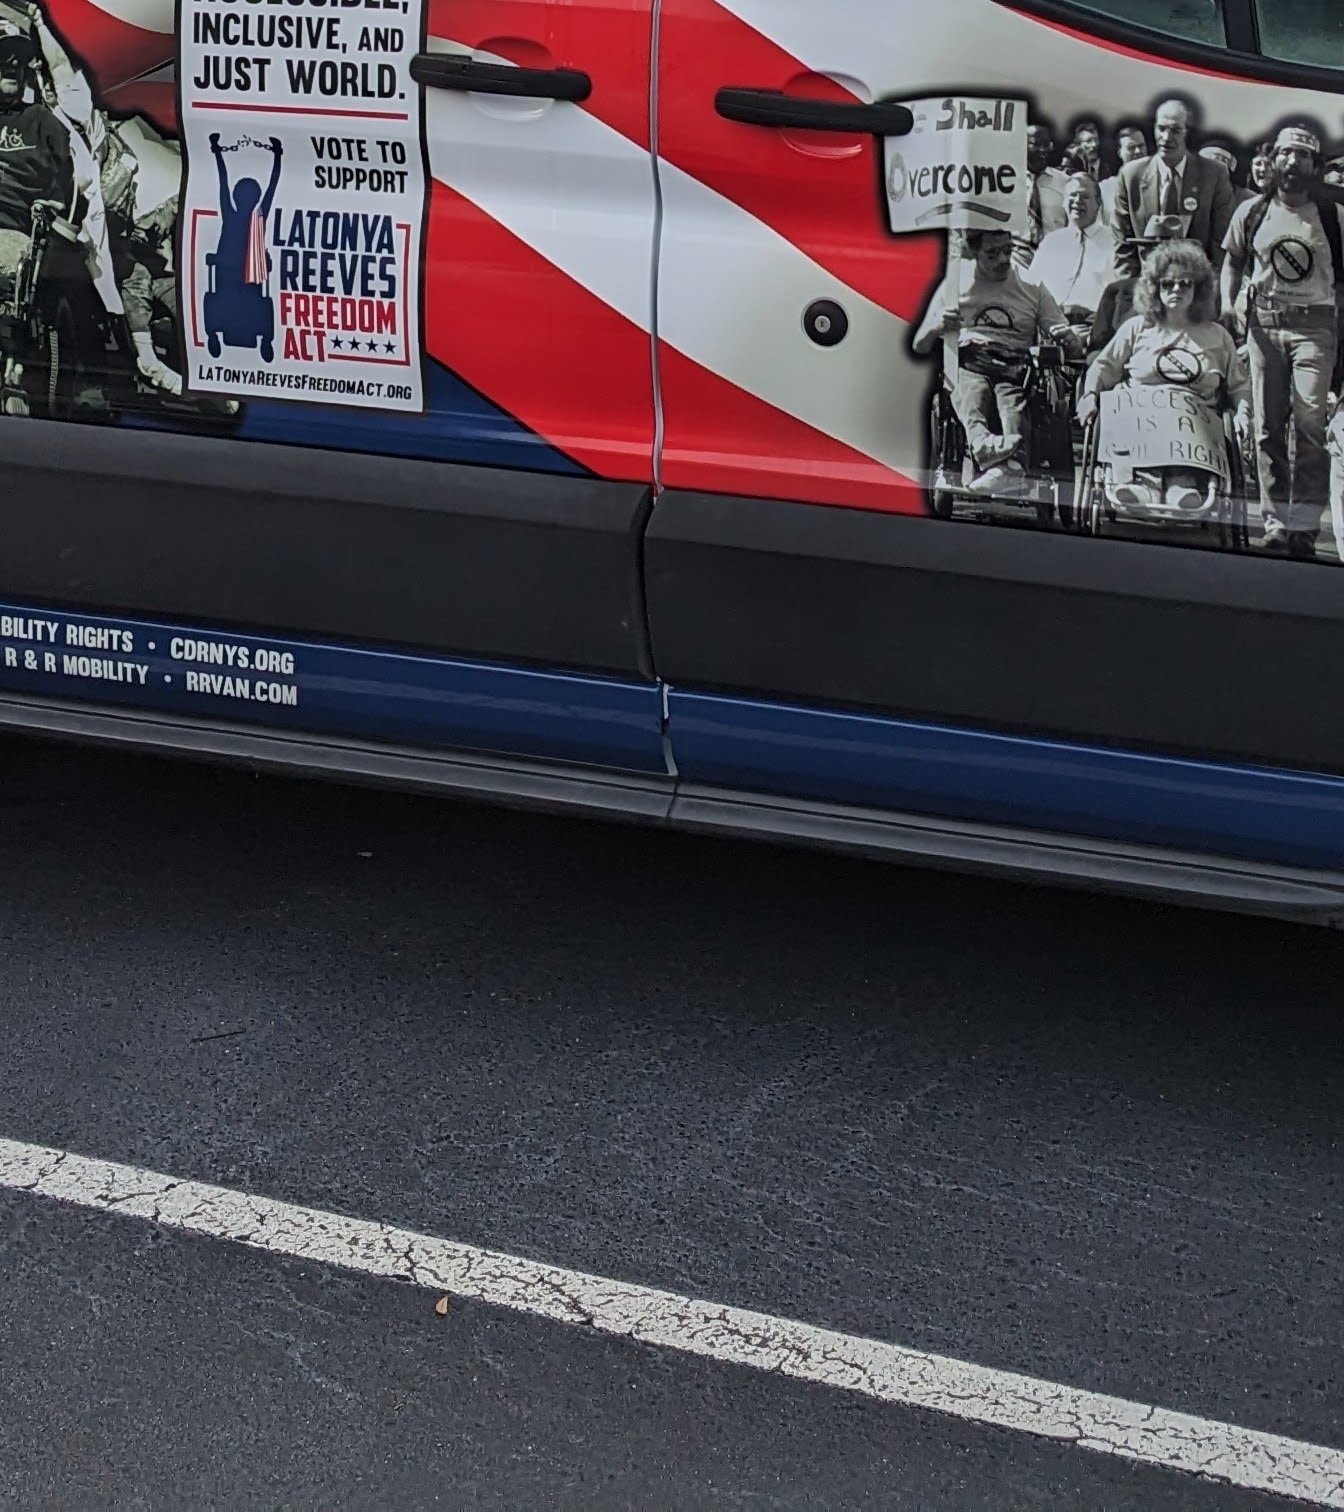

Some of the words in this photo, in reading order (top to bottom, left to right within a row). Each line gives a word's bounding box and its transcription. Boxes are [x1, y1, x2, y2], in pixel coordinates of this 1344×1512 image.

[193, 12, 347, 54] INCLUSIVE,
[358, 27, 403, 52] AND
[194, 55, 271, 92] JUST
[286, 59, 405, 99] WORLD.
[936, 99, 1014, 131] Shall
[310, 136, 368, 162] VOTE
[376, 140, 407, 164] TO
[314, 165, 408, 193] SUPPORT
[889, 152, 1016, 202] Overcome
[273, 208, 395, 254] LATONYA
[280, 249, 396, 299] REEVES
[280, 292, 396, 335] FREEDOM
[283, 328, 327, 362] ACT
[66, 624, 134, 653] RIGHTS
[170, 637, 295, 675] CDRNYS.ORG
[5, 647, 17, 668] R
[24, 650, 38, 670] &
[44, 652, 57, 672] R
[63, 655, 149, 685] MOBILITY
[186, 670, 298, 706] RRVAN.COM
